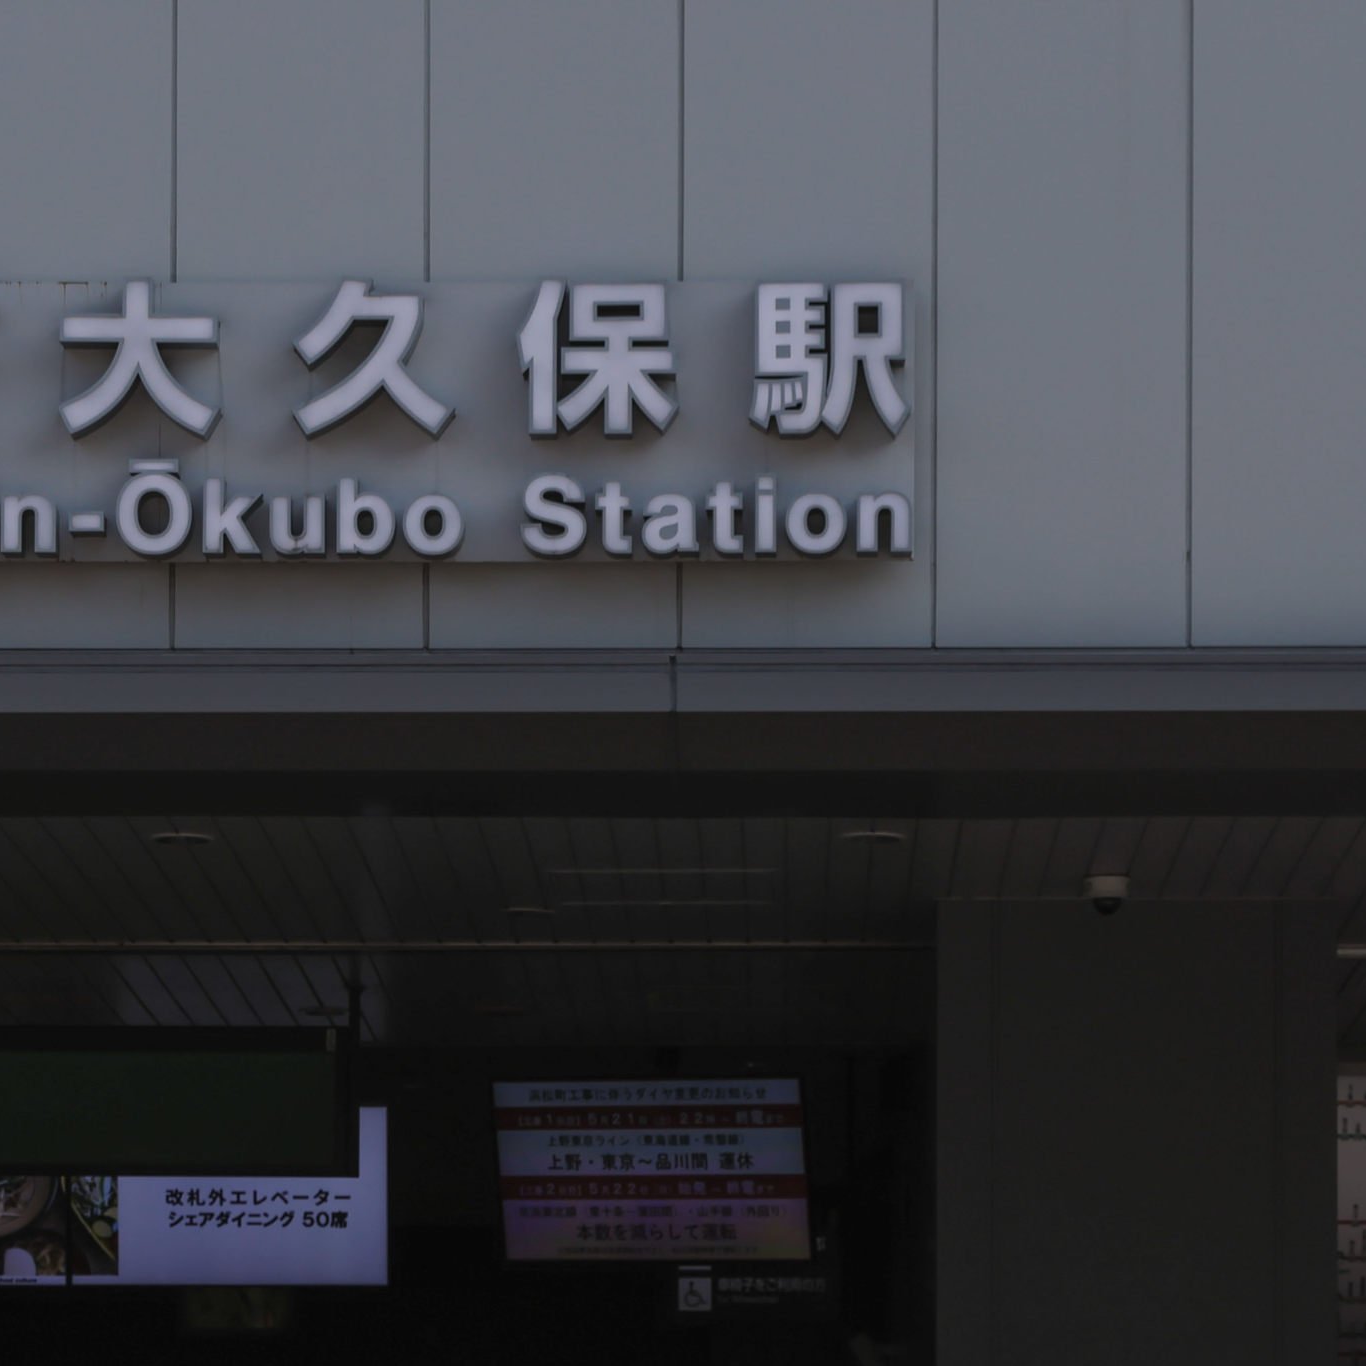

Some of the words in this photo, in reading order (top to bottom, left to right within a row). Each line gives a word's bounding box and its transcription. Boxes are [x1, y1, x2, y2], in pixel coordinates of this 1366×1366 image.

[522, 471, 911, 557] Station
[165, 1188, 351, 1207] 改札外エレベーター
[168, 1211, 295, 1228] シェアダイニング
[302, 1211, 349, 1229] 50席
